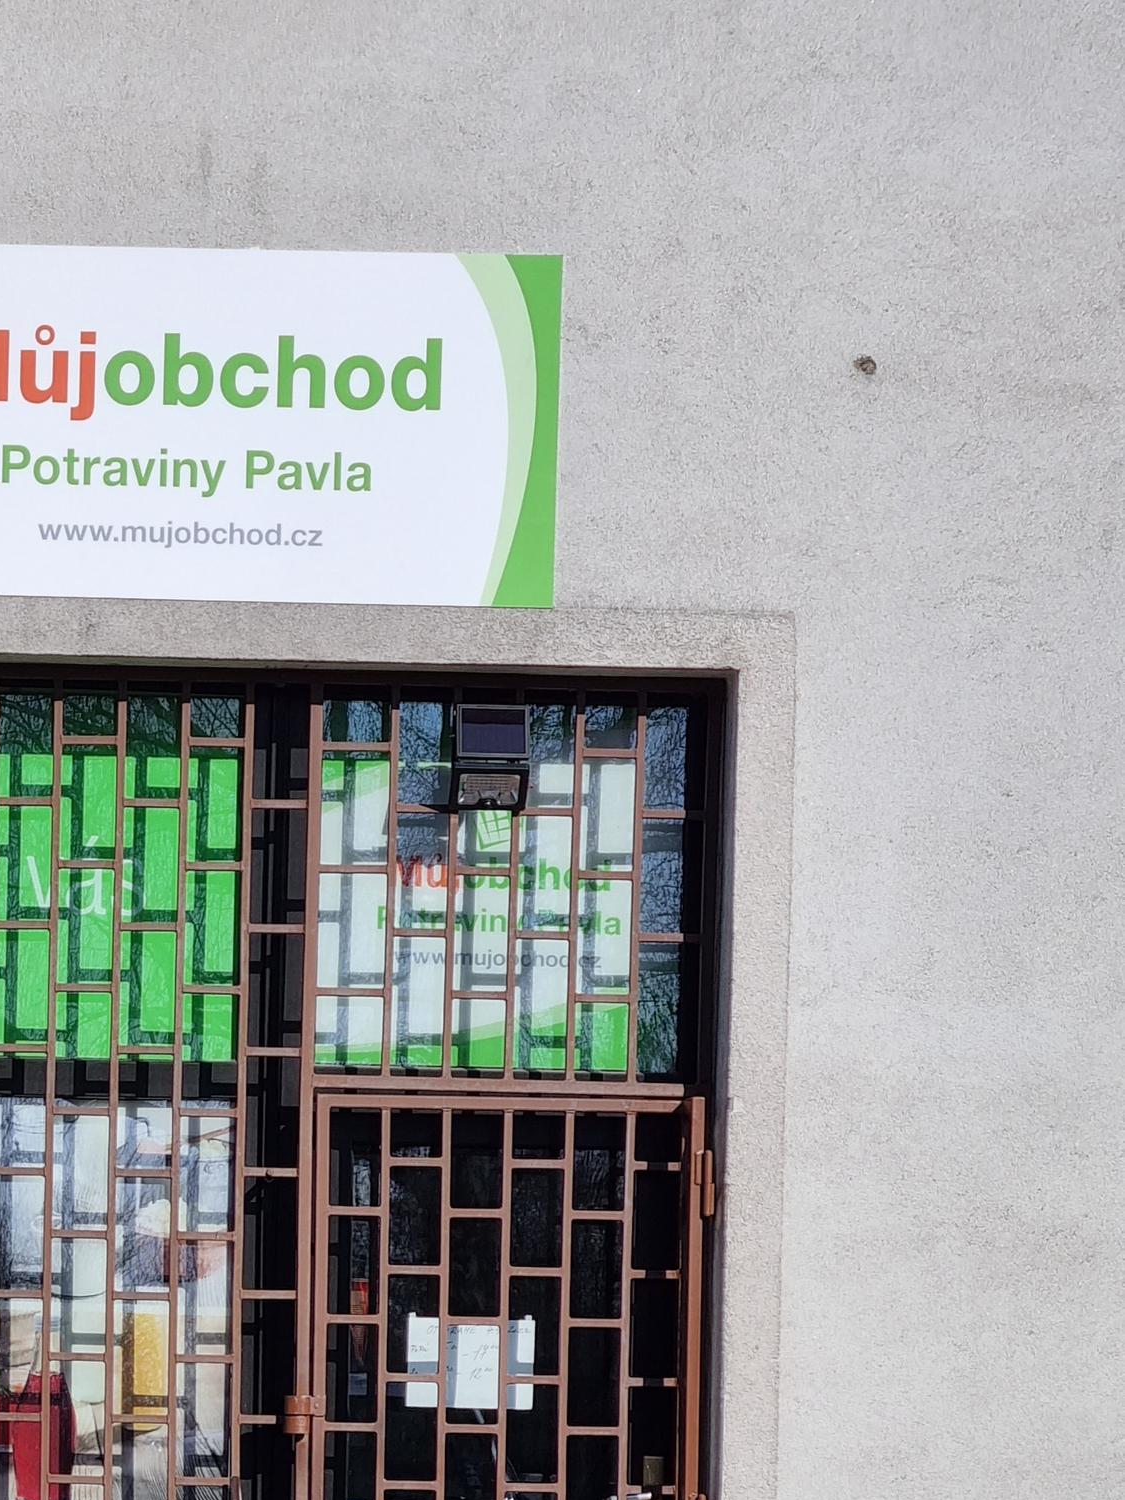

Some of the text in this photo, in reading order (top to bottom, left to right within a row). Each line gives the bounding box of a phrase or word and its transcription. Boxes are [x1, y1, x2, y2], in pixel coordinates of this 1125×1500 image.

[2, 445, 372, 497] Potraviny Pavla
[39, 521, 323, 549] www.mujobchod.cz
